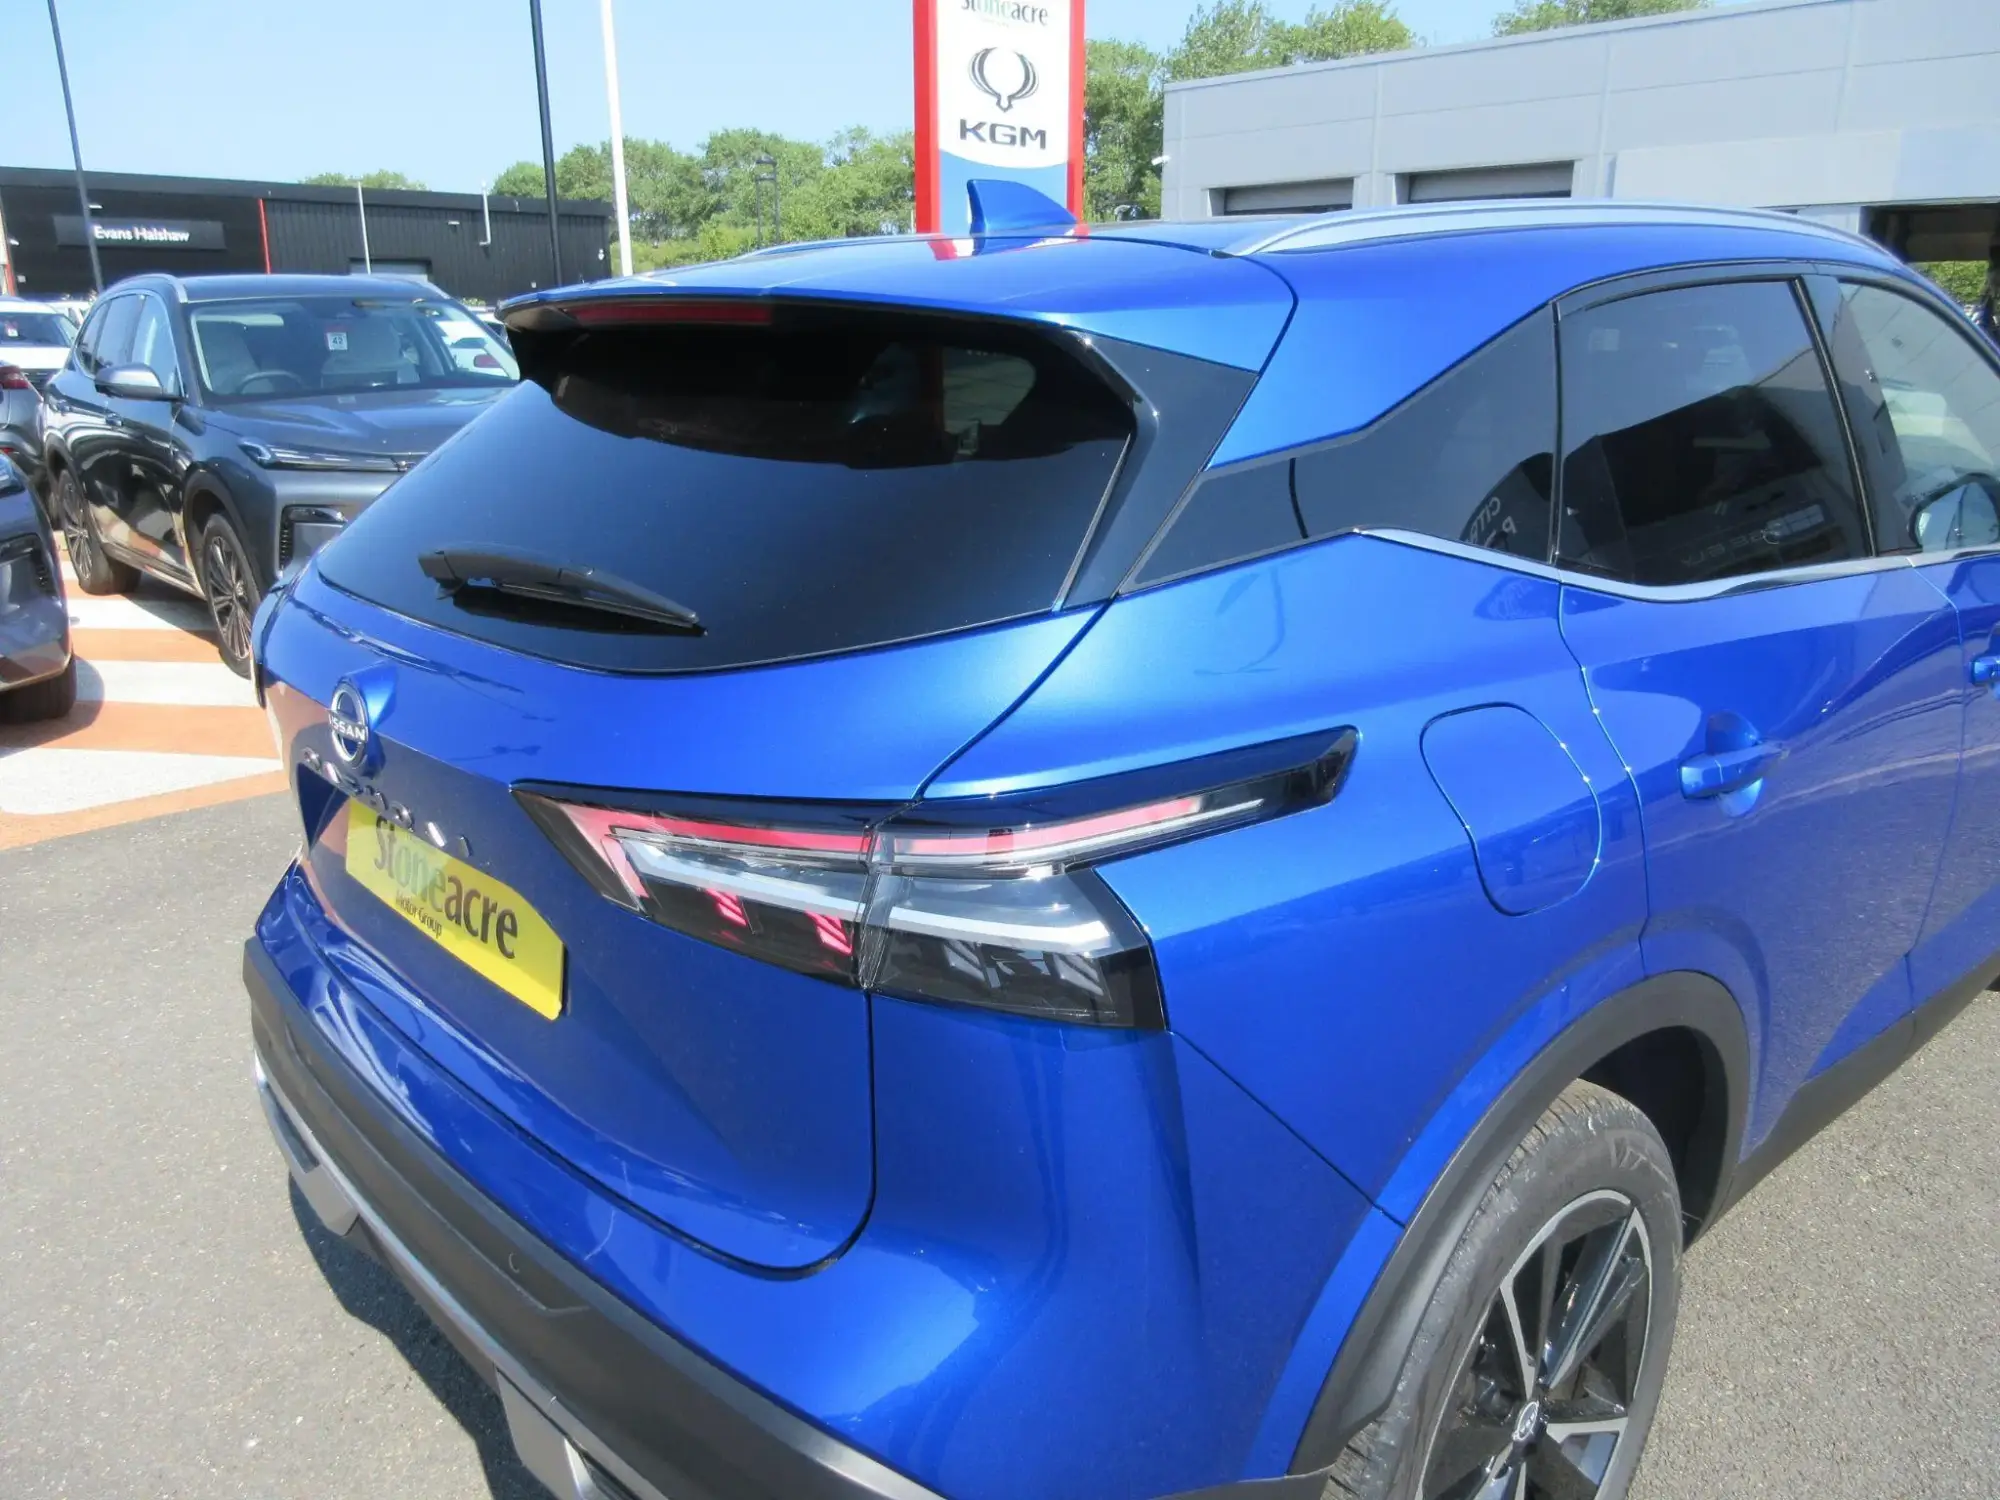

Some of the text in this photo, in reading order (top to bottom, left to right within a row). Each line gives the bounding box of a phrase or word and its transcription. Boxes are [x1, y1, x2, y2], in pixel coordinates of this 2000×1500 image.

[959, 118, 1047, 150] KGM
[93, 224, 190, 242] Evans Halshaw
[374, 815, 518, 960] Stoneacre
[419, 907, 442, 940] Group
